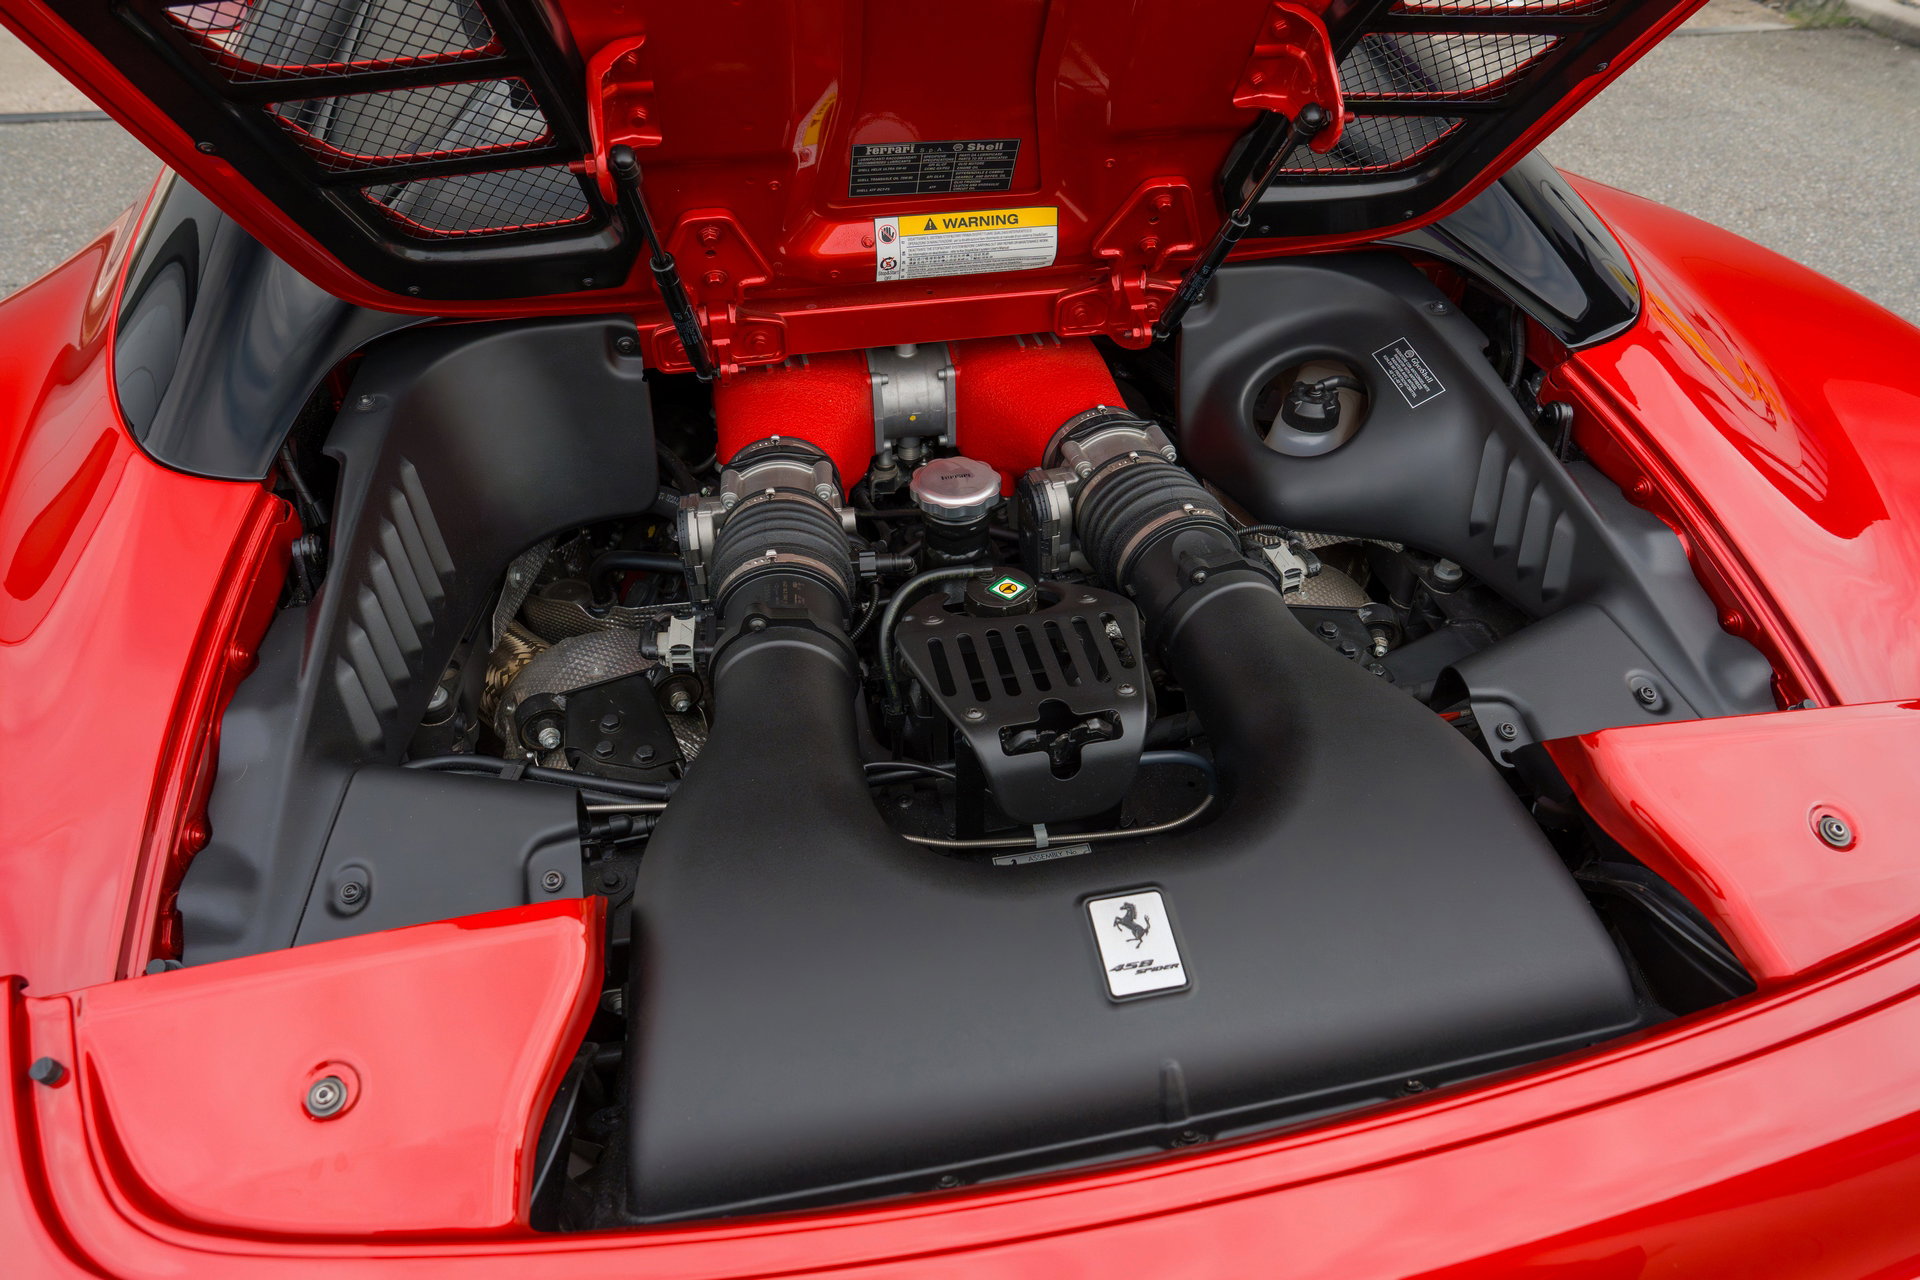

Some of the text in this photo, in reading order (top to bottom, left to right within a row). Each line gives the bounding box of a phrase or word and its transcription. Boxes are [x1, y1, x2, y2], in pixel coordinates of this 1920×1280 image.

[866, 144, 915, 155] Ferrari
[967, 142, 1003, 151] Shell
[943, 214, 1018, 229] WARNING
[1411, 358, 1433, 383] GlycoShell
[1028, 851, 1063, 862] ASSEMBLY
[1109, 959, 1154, 972] 458
[1135, 963, 1180, 975] SPIDER
